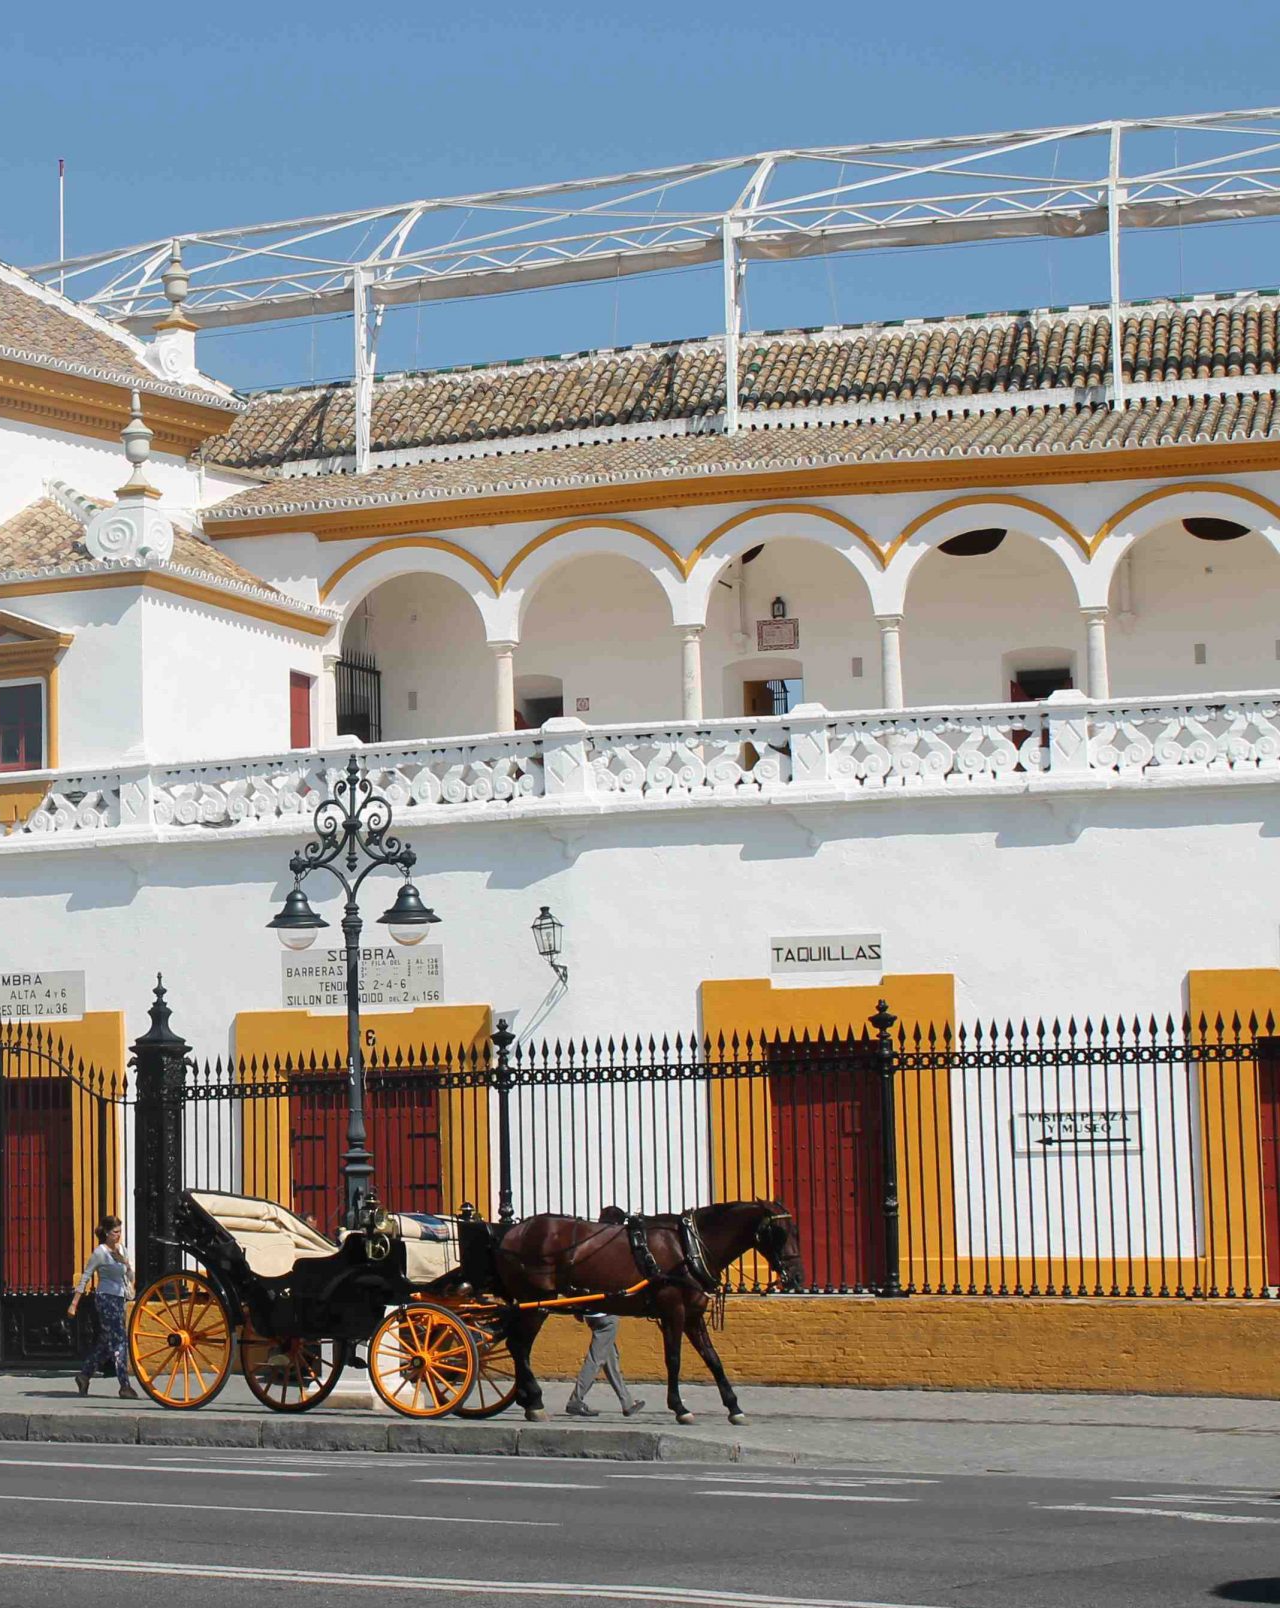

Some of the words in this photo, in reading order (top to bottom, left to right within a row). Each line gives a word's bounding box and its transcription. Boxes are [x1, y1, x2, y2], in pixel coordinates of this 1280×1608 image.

[772, 944, 881, 962] TAQUILLAS
[286, 966, 343, 977] BARRERAS
[319, 980, 365, 992] TENDIS
[373, 979, 406, 990] 2-4-6
[10, 990, 36, 1000] ALTA
[45, 989, 50, 998] 4
[61, 989, 66, 998] 6
[287, 995, 322, 1006] SILLON
[326, 994, 338, 1004] DE
[343, 993, 383, 1003] TDIDO
[403, 992, 409, 1001] 2
[423, 990, 439, 1001] 156
[16, 1005, 31, 1015] DEL
[35, 1004, 43, 1014] 12
[56, 1003, 67, 1014] 36
[366, 1029, 376, 1046] 6
[1029, 1112, 1075, 1122] VISITA
[1081, 1112, 1128, 1121] PLAZA
[1048, 1125, 1055, 1133] Y
[1062, 1124, 1111, 1133] MUSEO
